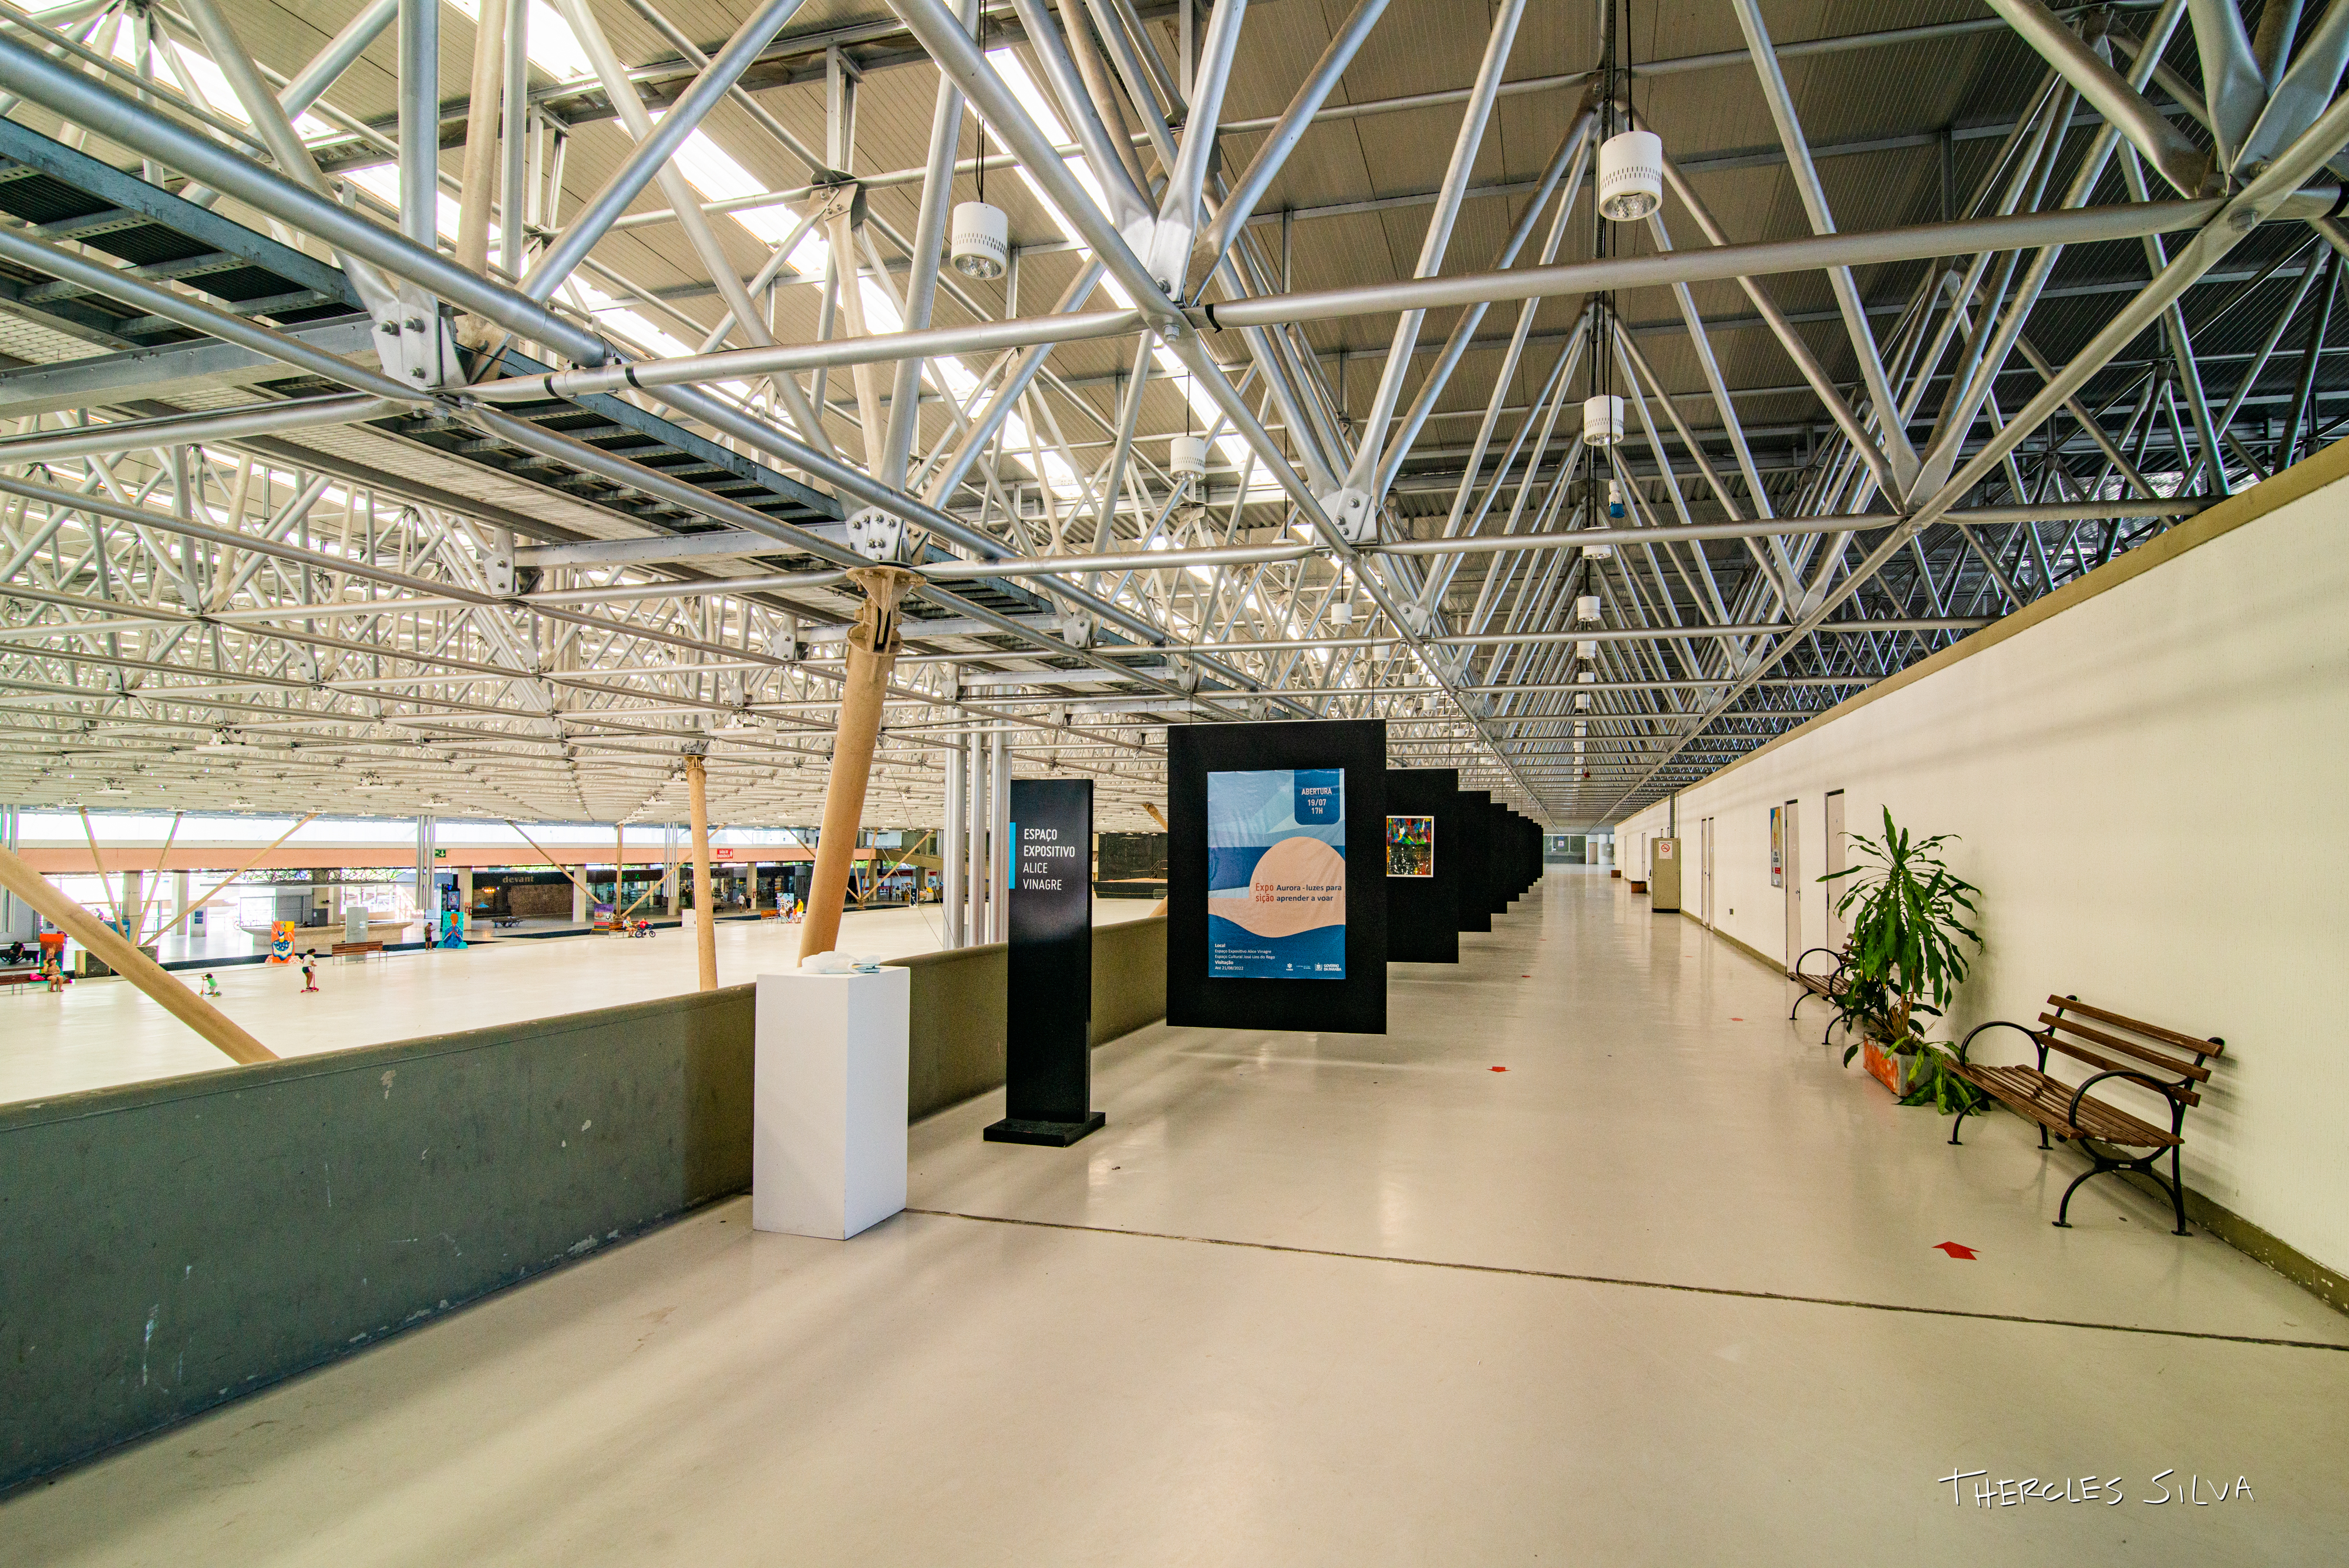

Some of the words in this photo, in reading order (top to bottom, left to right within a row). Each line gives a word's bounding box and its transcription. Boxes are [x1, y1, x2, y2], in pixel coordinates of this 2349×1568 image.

[1024, 829, 1057, 842] ESPAÇO
[1024, 845, 1075, 857] EXPOSITIVO
[1023, 862, 1048, 874] ALICE
[502, 875, 534, 883] devant
[1023, 879, 1062, 890] VINAGRE
[1256, 883, 1274, 893] Expo
[1256, 893, 1274, 903] sição
